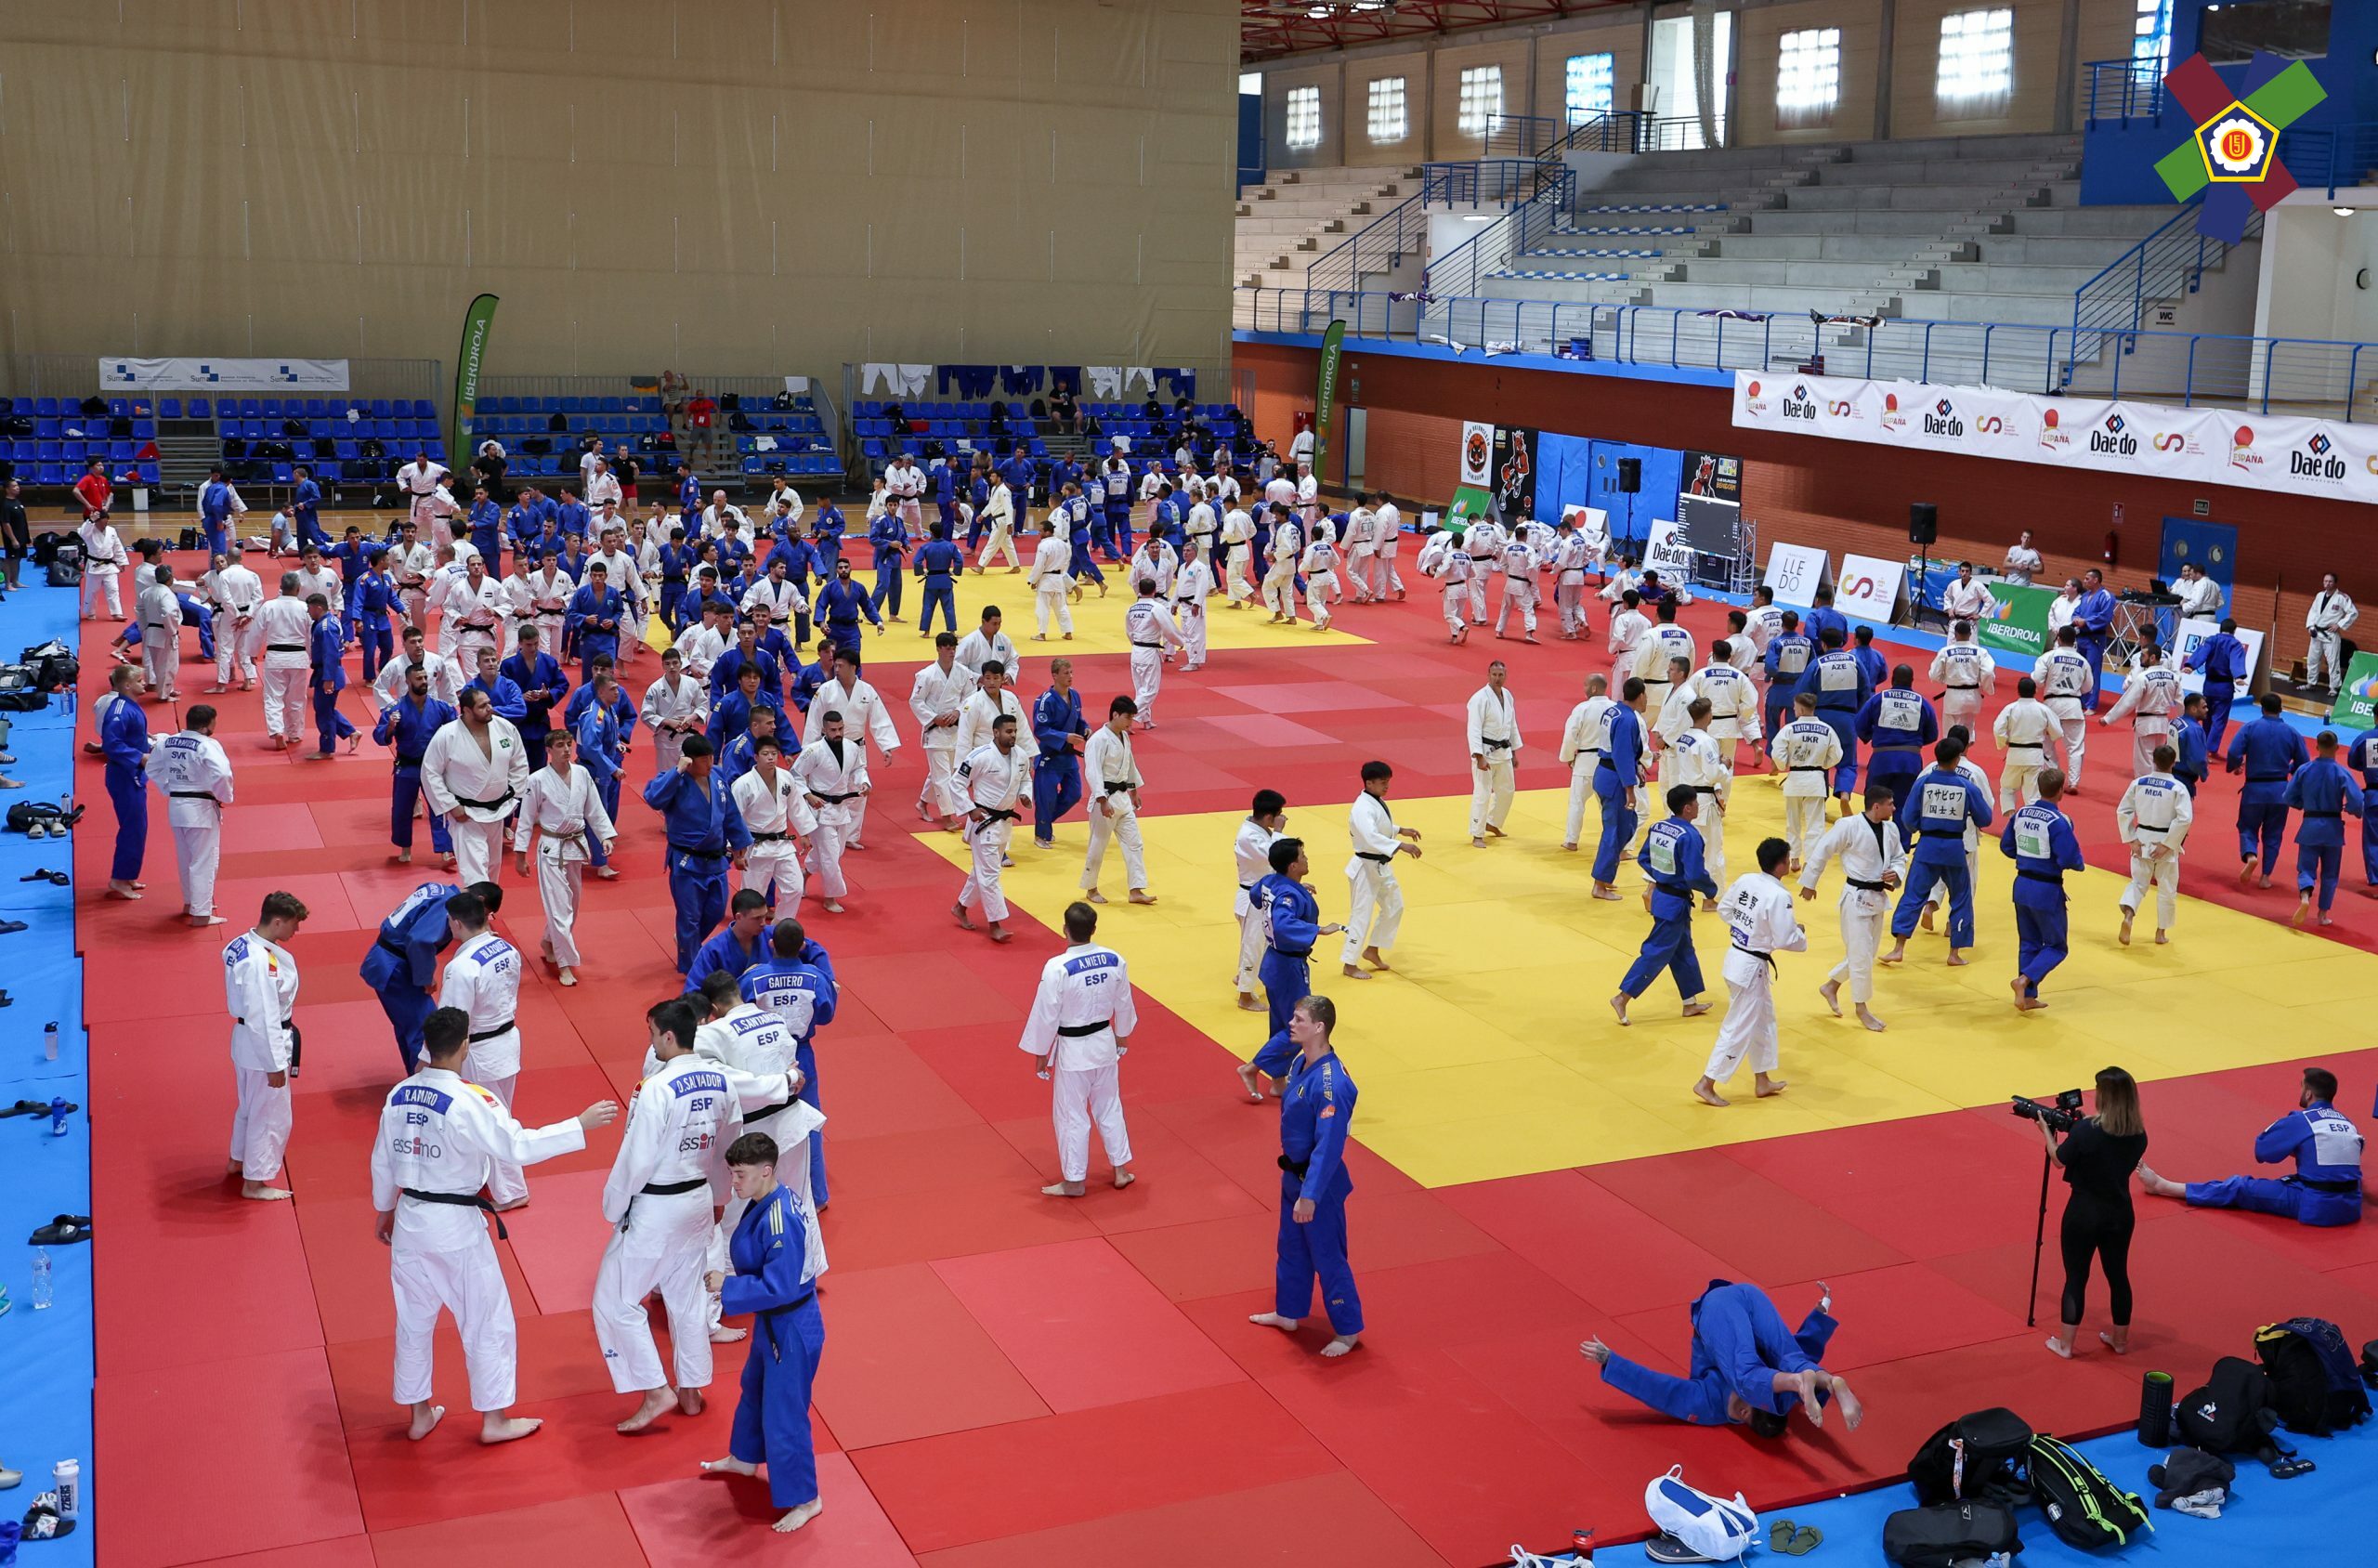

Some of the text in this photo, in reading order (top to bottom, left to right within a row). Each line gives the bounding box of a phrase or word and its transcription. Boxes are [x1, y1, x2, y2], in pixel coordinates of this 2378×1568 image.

[2159, 311, 2174, 320] WC
[464, 319, 486, 401] IBERDROLA
[1322, 344, 1338, 423] IBERDROLA
[2233, 452, 2264, 464] ESPAÑA
[1783, 557, 1806, 576] LLE
[1778, 574, 1799, 592] DO
[1987, 622, 2041, 643] IBERDROLA
[171, 751, 186, 760] SVK
[1926, 789, 1963, 803] マサビロフ
[2145, 788, 2162, 798] MDA
[1928, 805, 1957, 816] 国士大
[2023, 821, 2040, 832] NOR
[1655, 836, 1669, 848] KAZ
[494, 958, 510, 973] ESP
[1078, 954, 1107, 970] A.NIETO
[768, 975, 803, 989] GAITERO
[1084, 973, 1108, 987] ESP
[773, 995, 798, 1006] ESP
[757, 1030, 779, 1046] ESP
[690, 1097, 713, 1112] ESP
[406, 1111, 429, 1127] ESP
[2329, 1123, 2350, 1133] ESP
[393, 1136, 441, 1159] essimo
